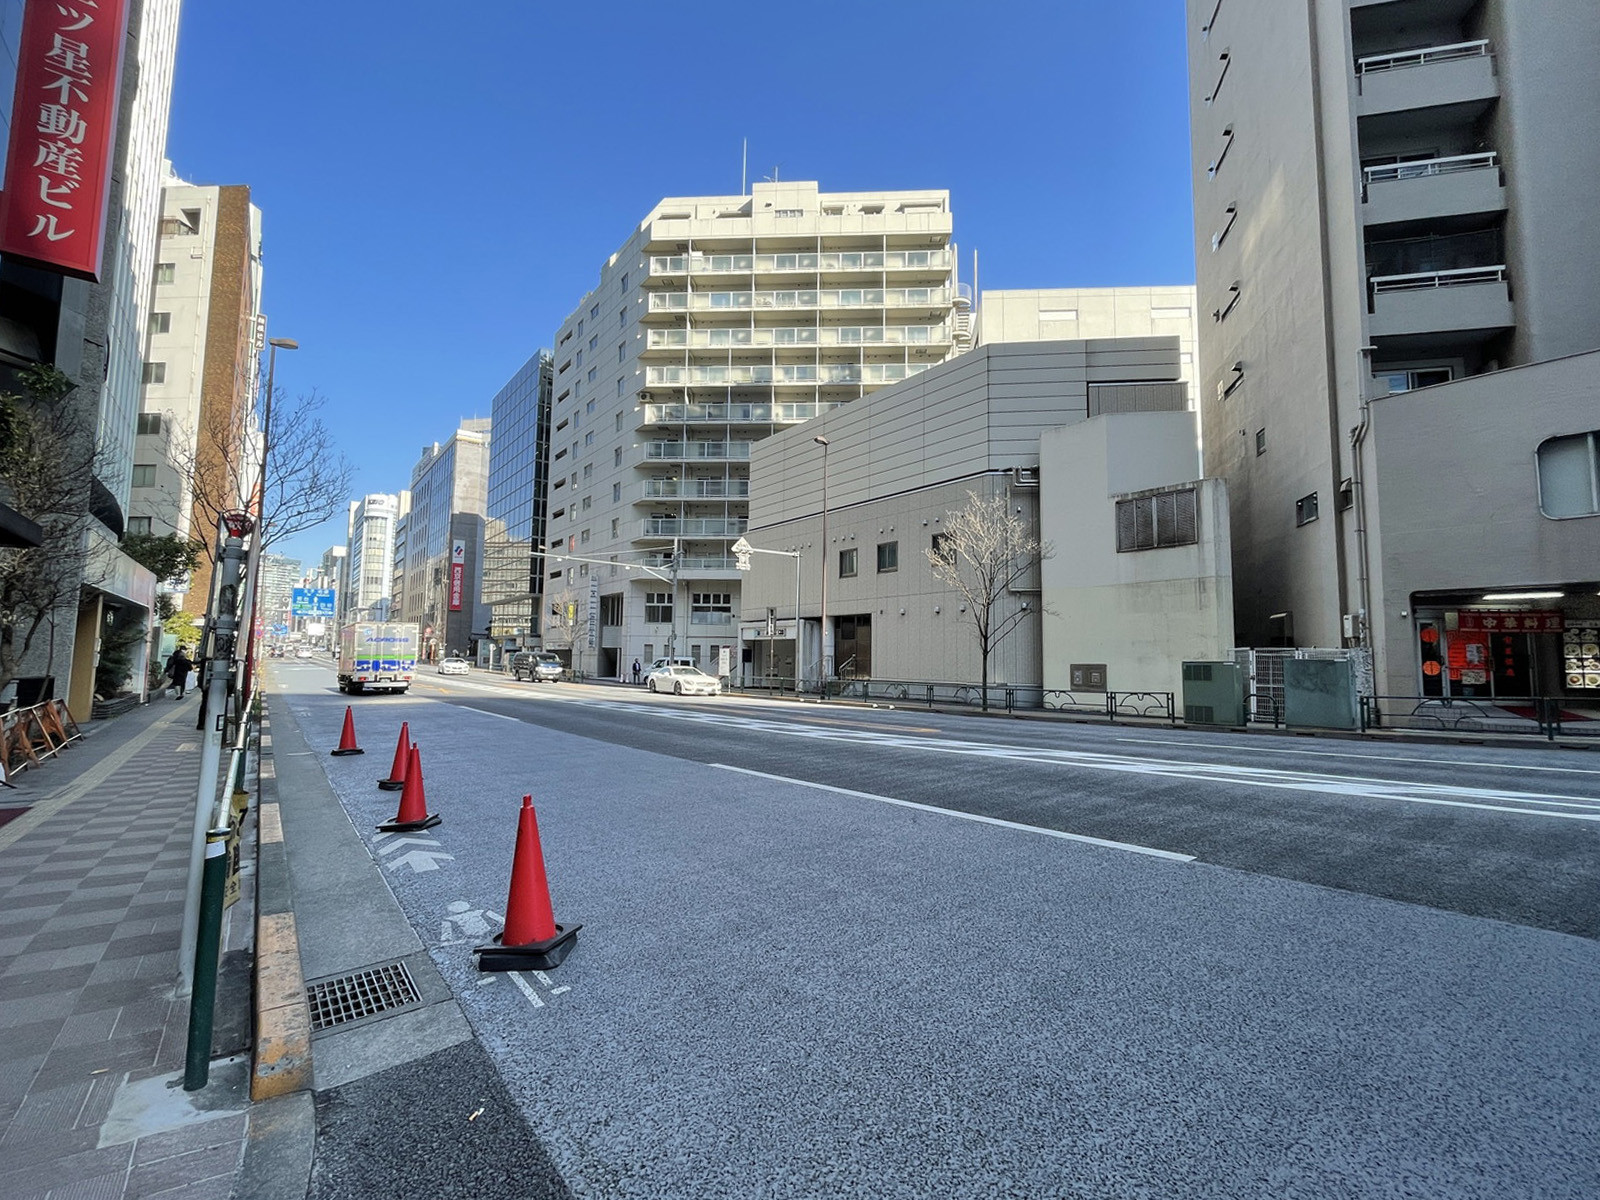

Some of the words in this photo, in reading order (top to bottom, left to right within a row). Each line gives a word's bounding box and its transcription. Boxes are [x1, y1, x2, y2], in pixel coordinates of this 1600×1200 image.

[27, 0, 98, 242] ツ星不動産ビル
